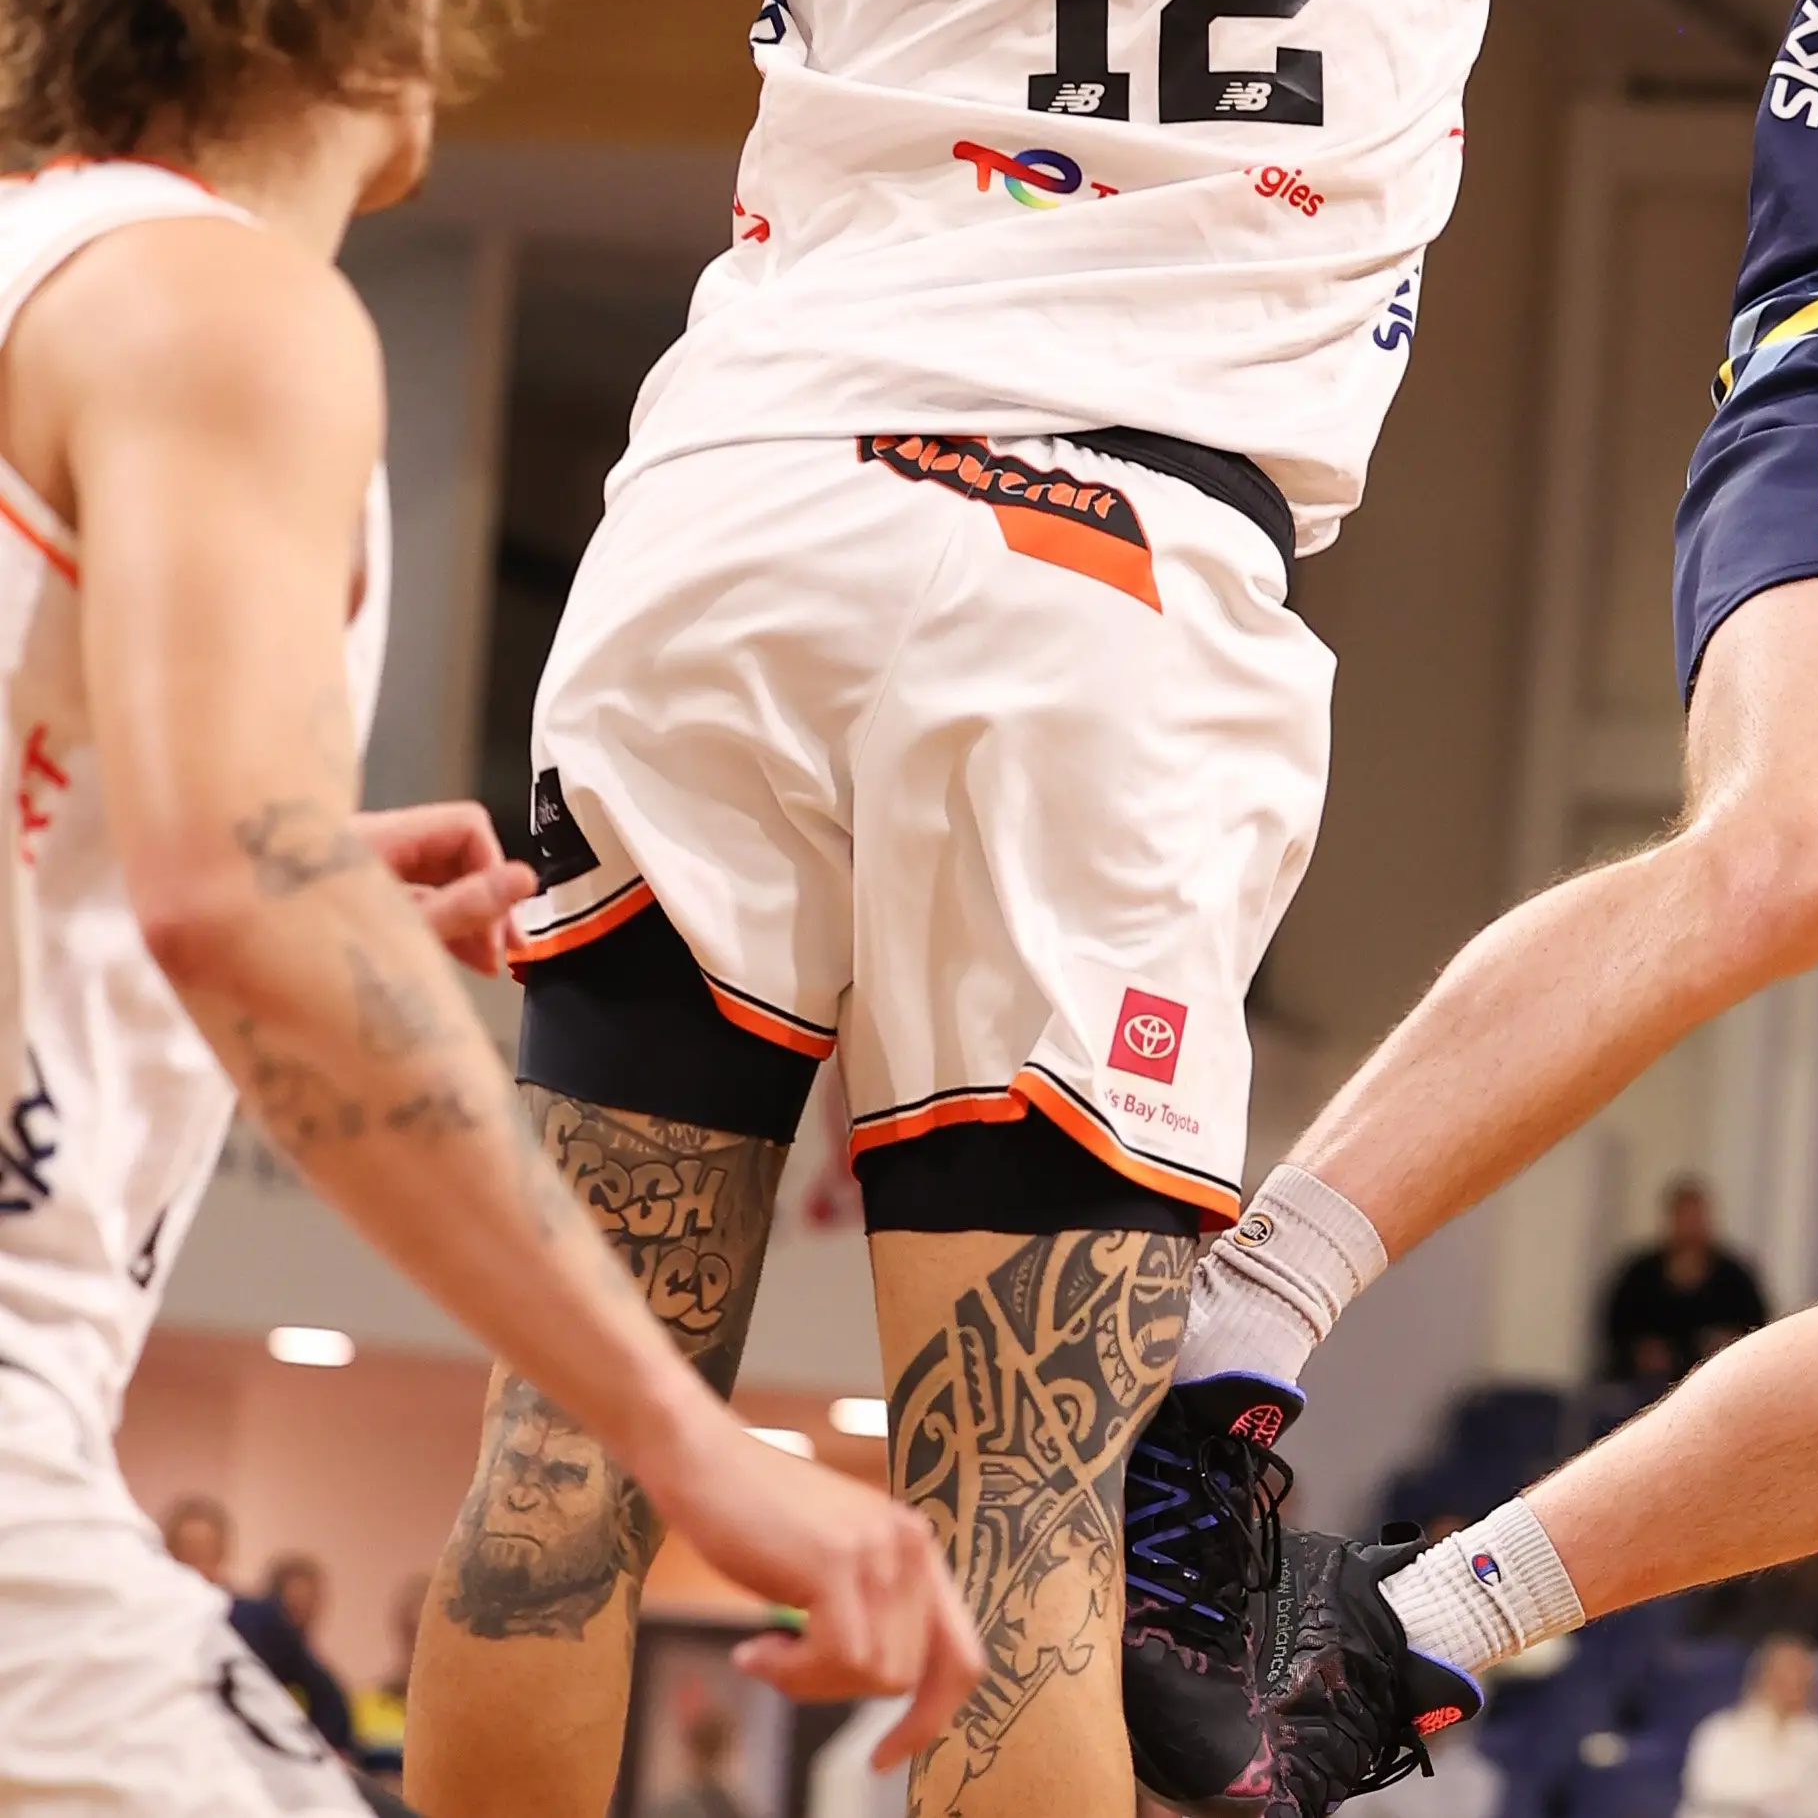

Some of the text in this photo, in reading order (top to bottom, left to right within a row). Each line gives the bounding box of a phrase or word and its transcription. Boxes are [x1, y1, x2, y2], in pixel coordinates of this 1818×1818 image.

[1124, 1093, 1157, 1123] Bay
[1161, 1104, 1199, 1135] Toyota
[1266, 1597, 1295, 1683] balance
